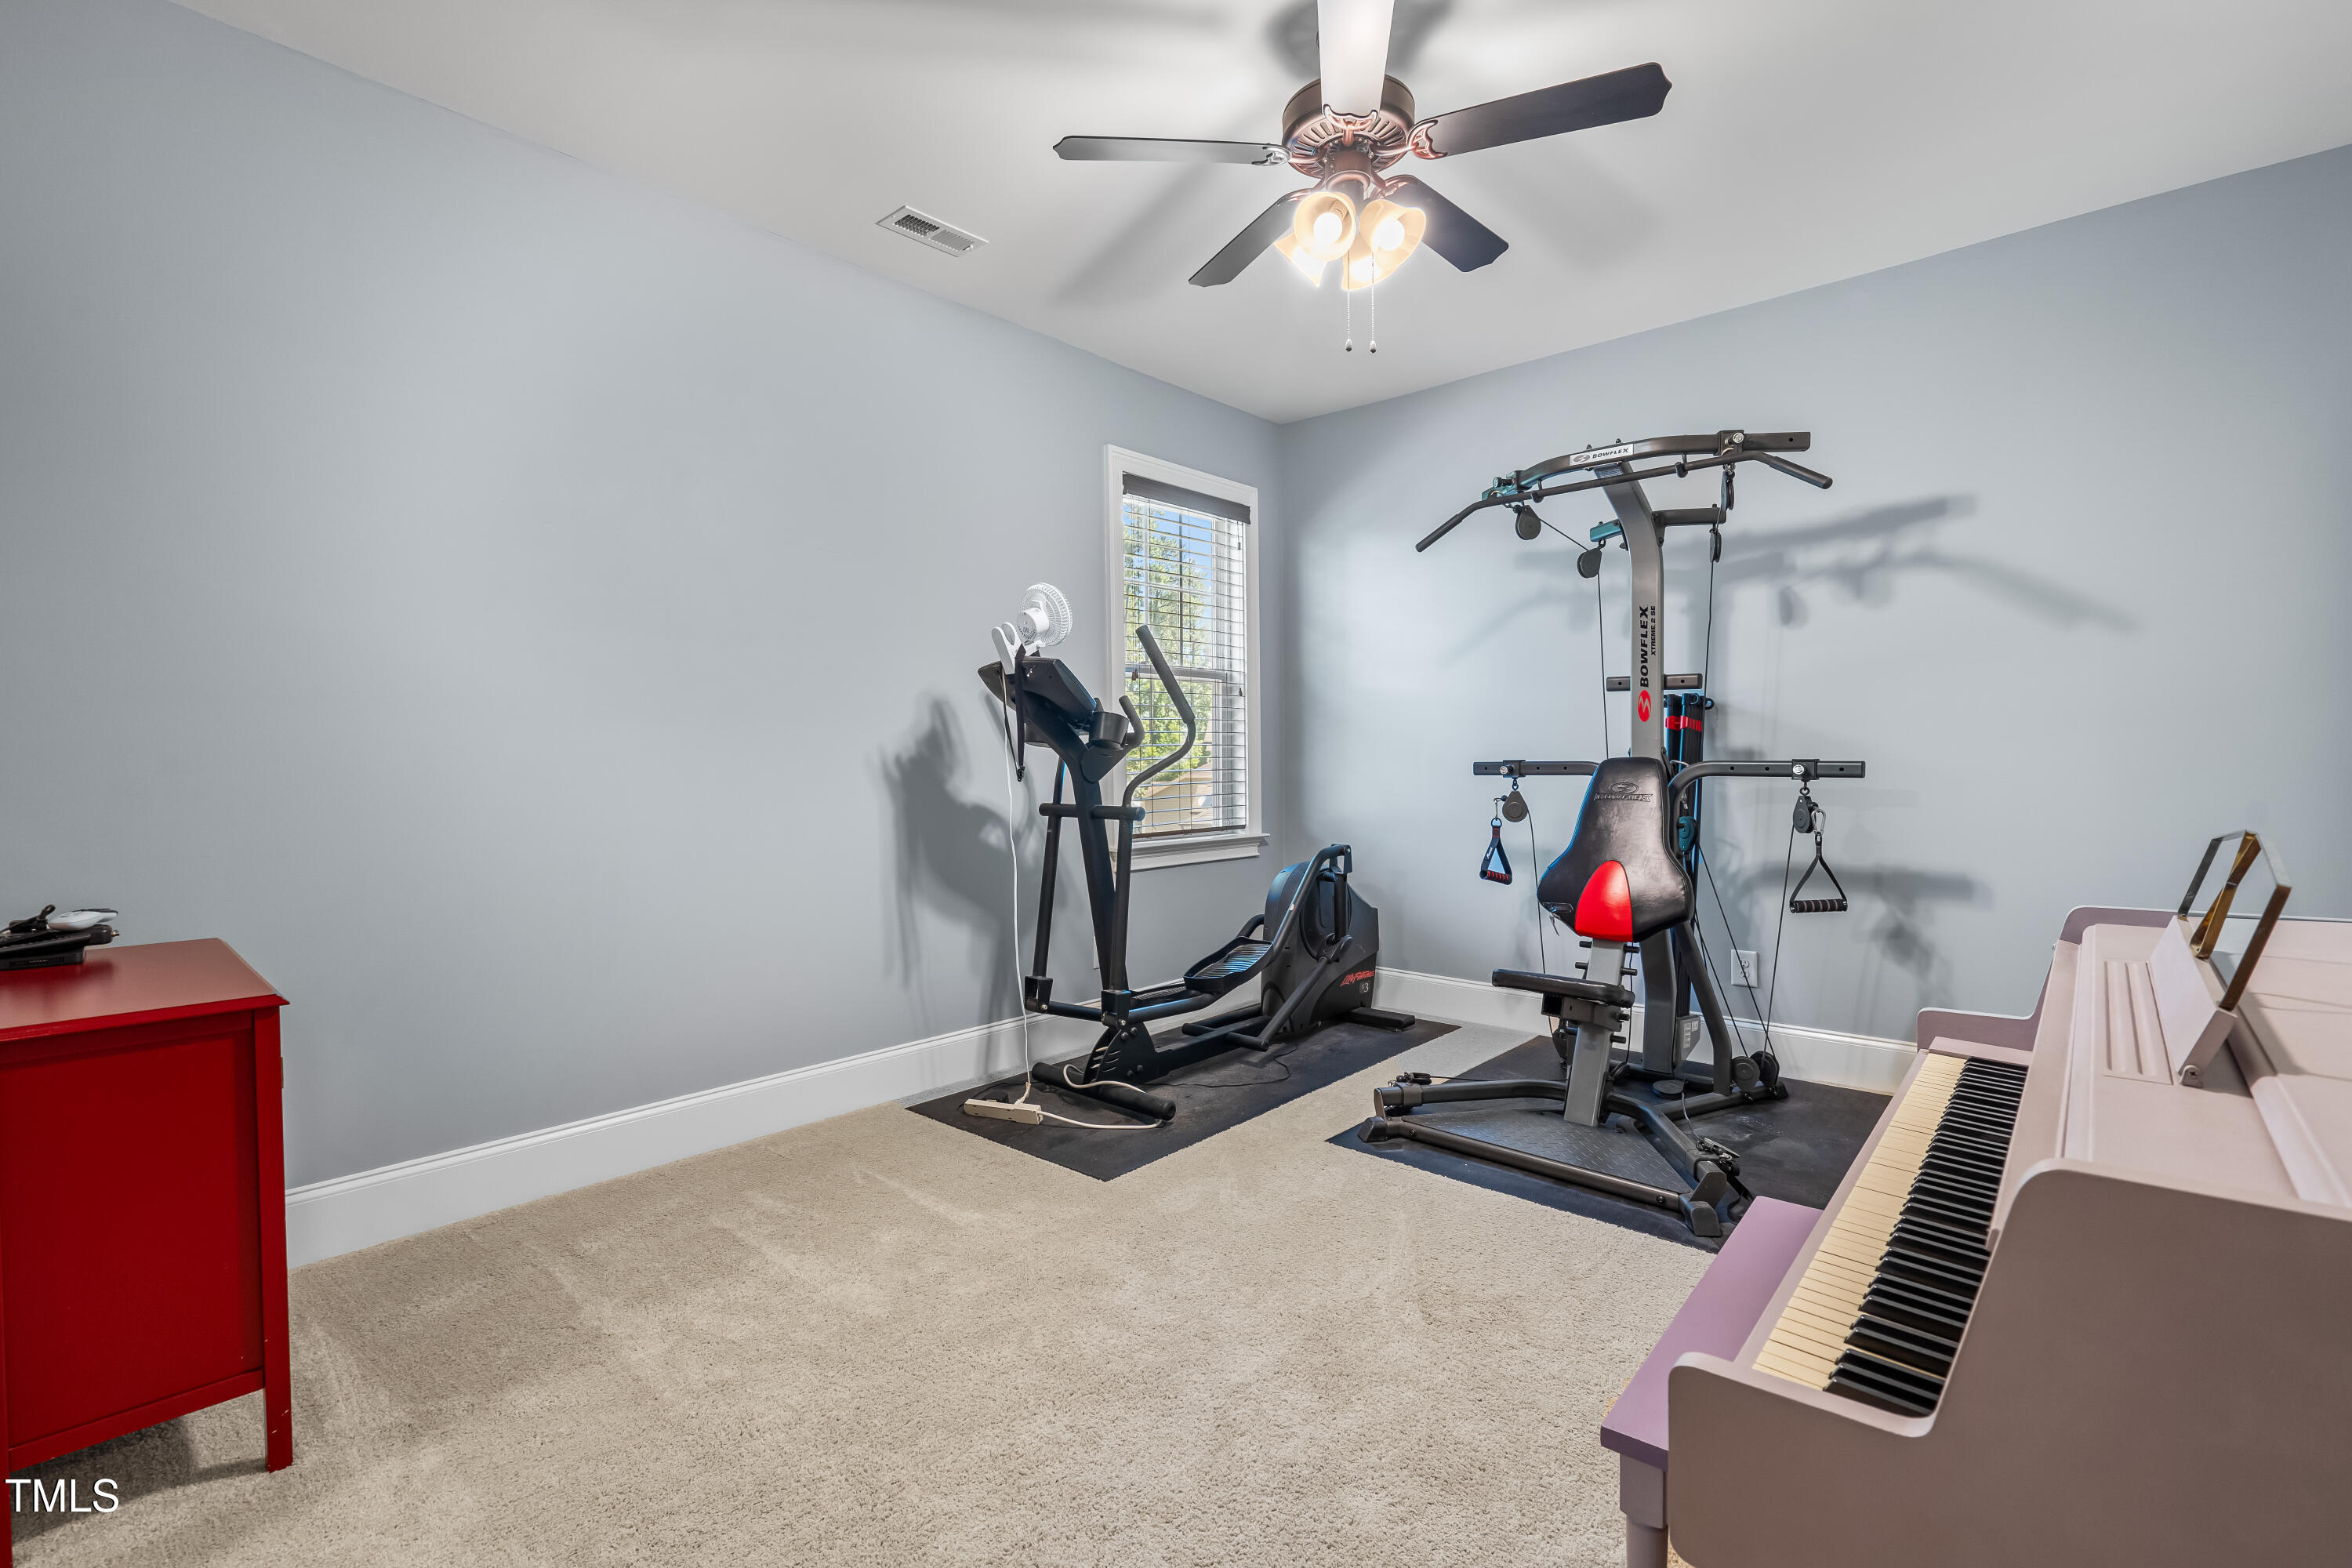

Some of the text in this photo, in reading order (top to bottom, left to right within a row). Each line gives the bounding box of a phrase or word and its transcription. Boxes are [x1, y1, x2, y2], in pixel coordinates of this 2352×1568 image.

[1592, 448, 1628, 459] BOWFLEX
[1650, 605, 1656, 617] SE
[1639, 605, 1649, 688] BOWFLEX
